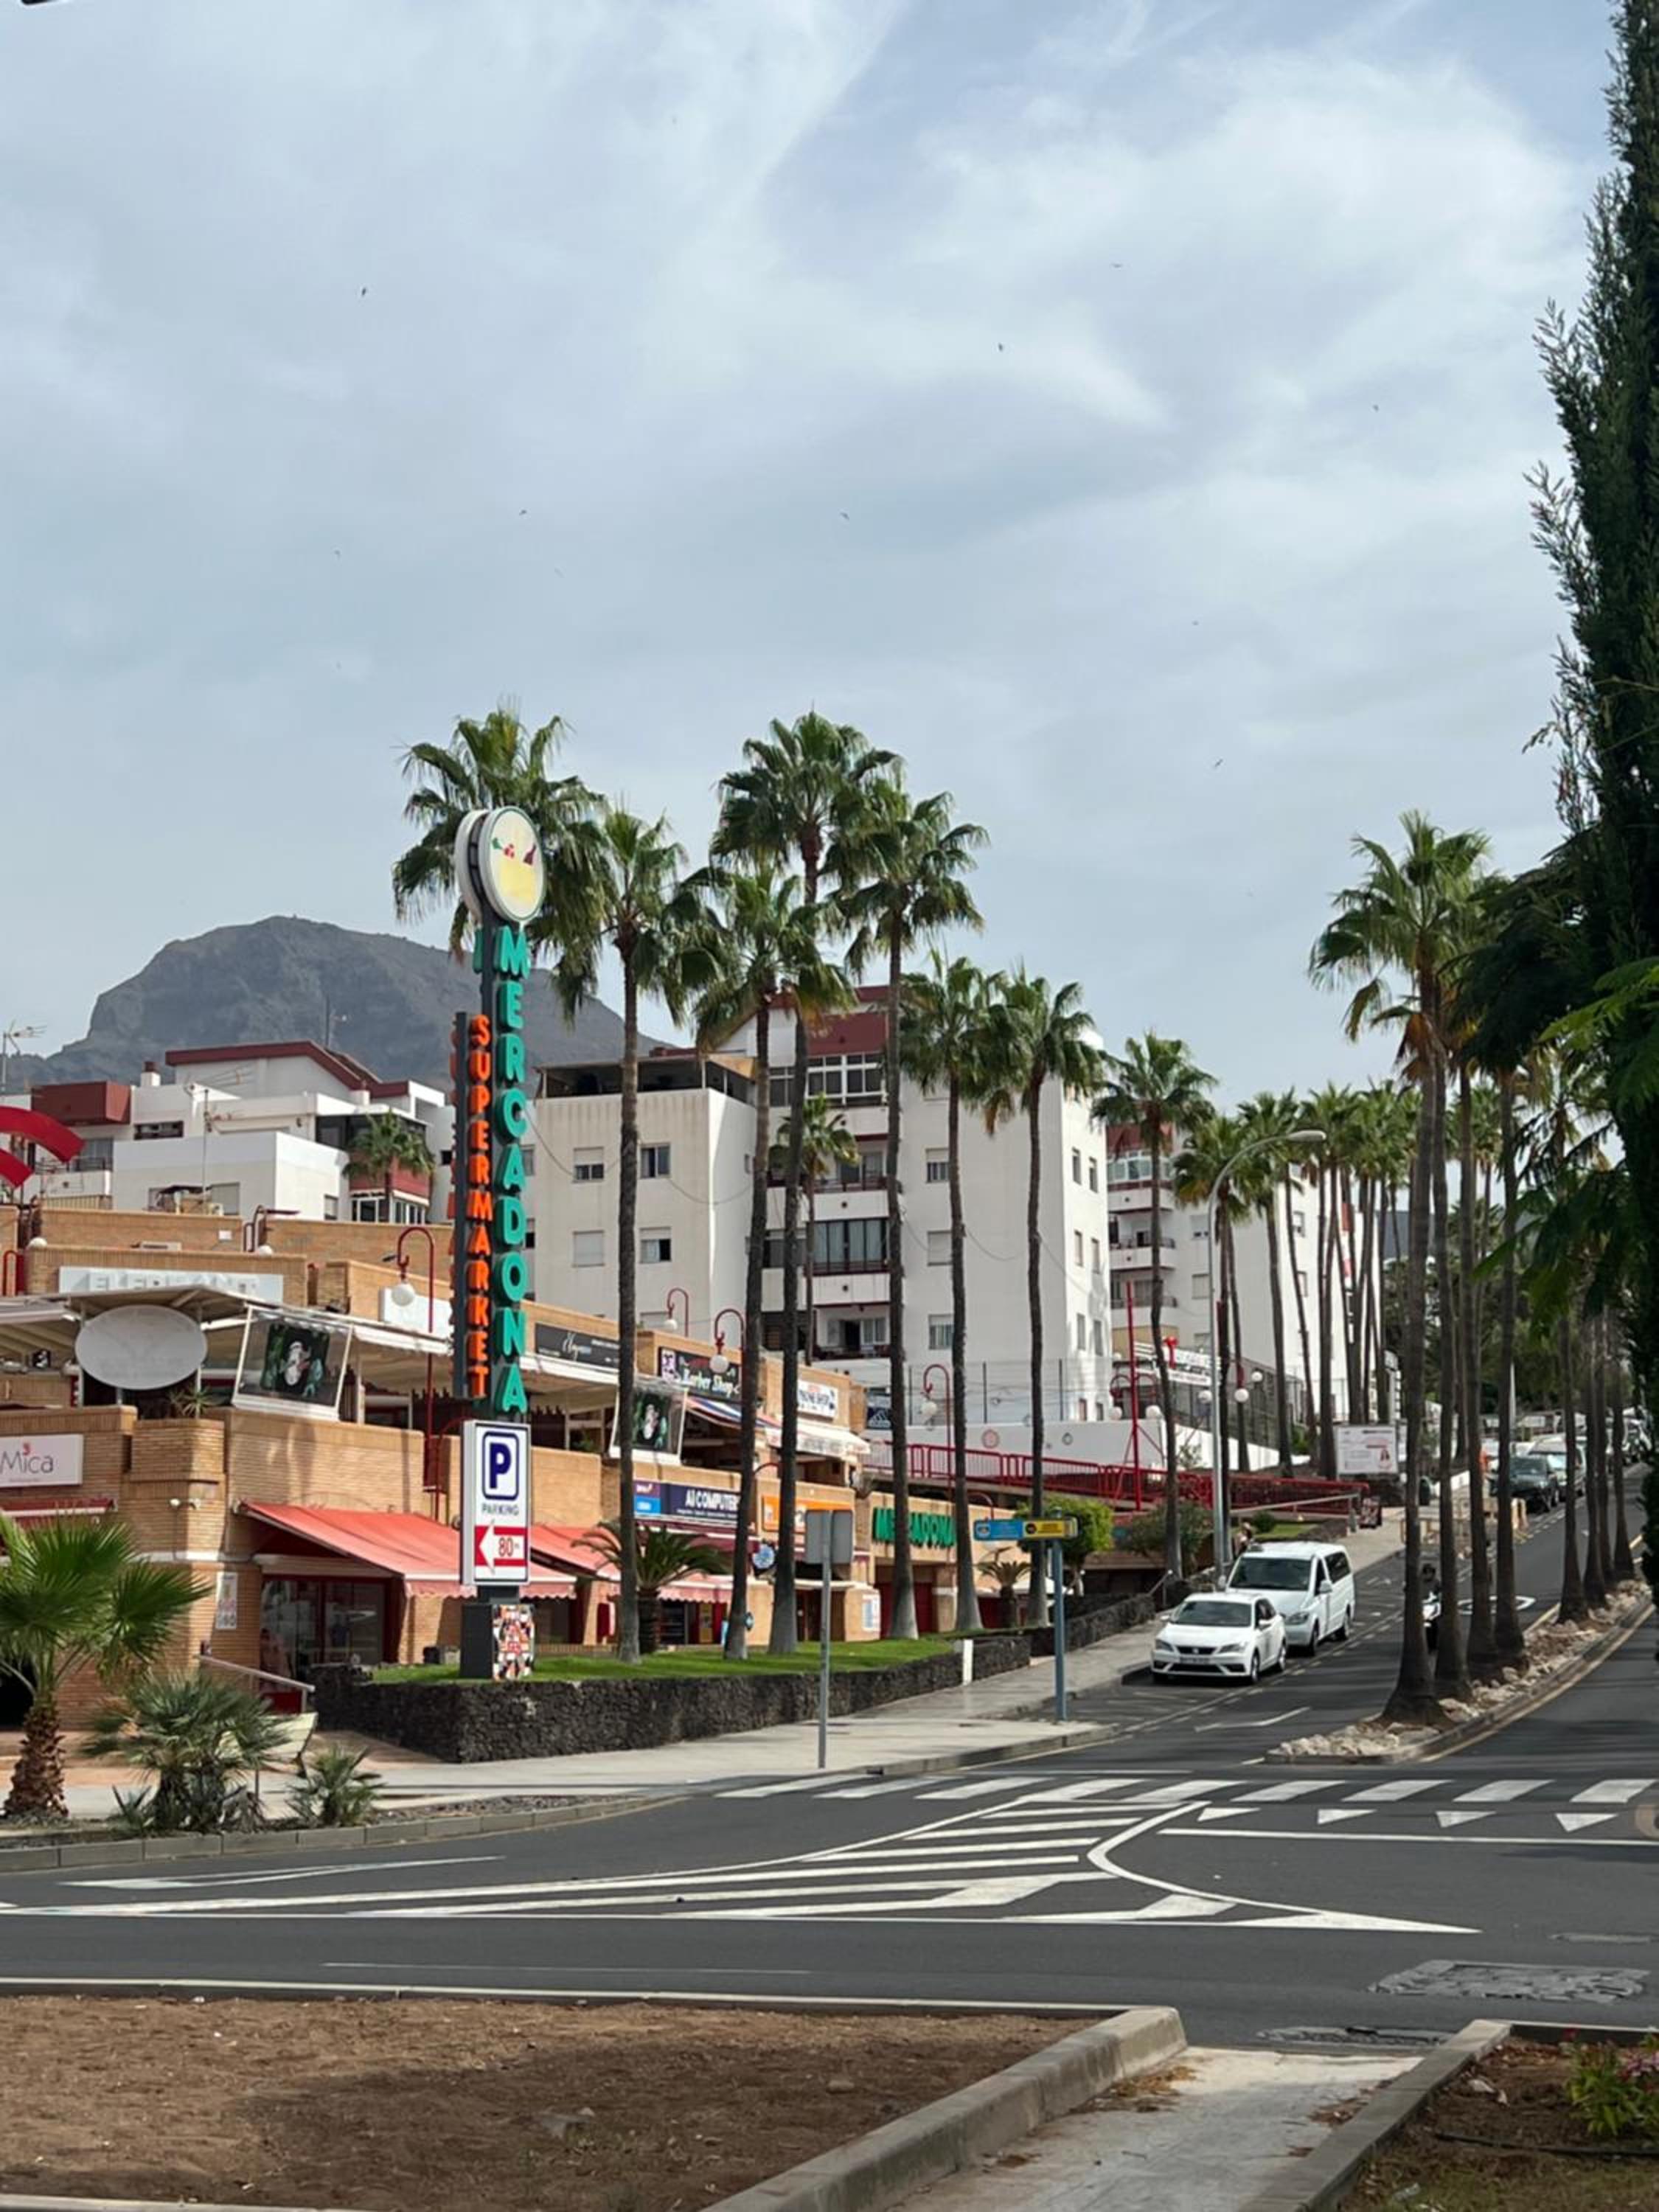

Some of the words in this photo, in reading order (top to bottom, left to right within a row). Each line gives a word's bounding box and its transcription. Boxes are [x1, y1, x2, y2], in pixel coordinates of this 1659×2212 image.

[494, 925, 530, 1413] MERCADONA
[467, 1014, 493, 1399] SUPERMARKET
[0, 1443, 54, 1474] Mica
[490, 1441, 511, 1489] P
[481, 1503, 519, 1517] PARKING
